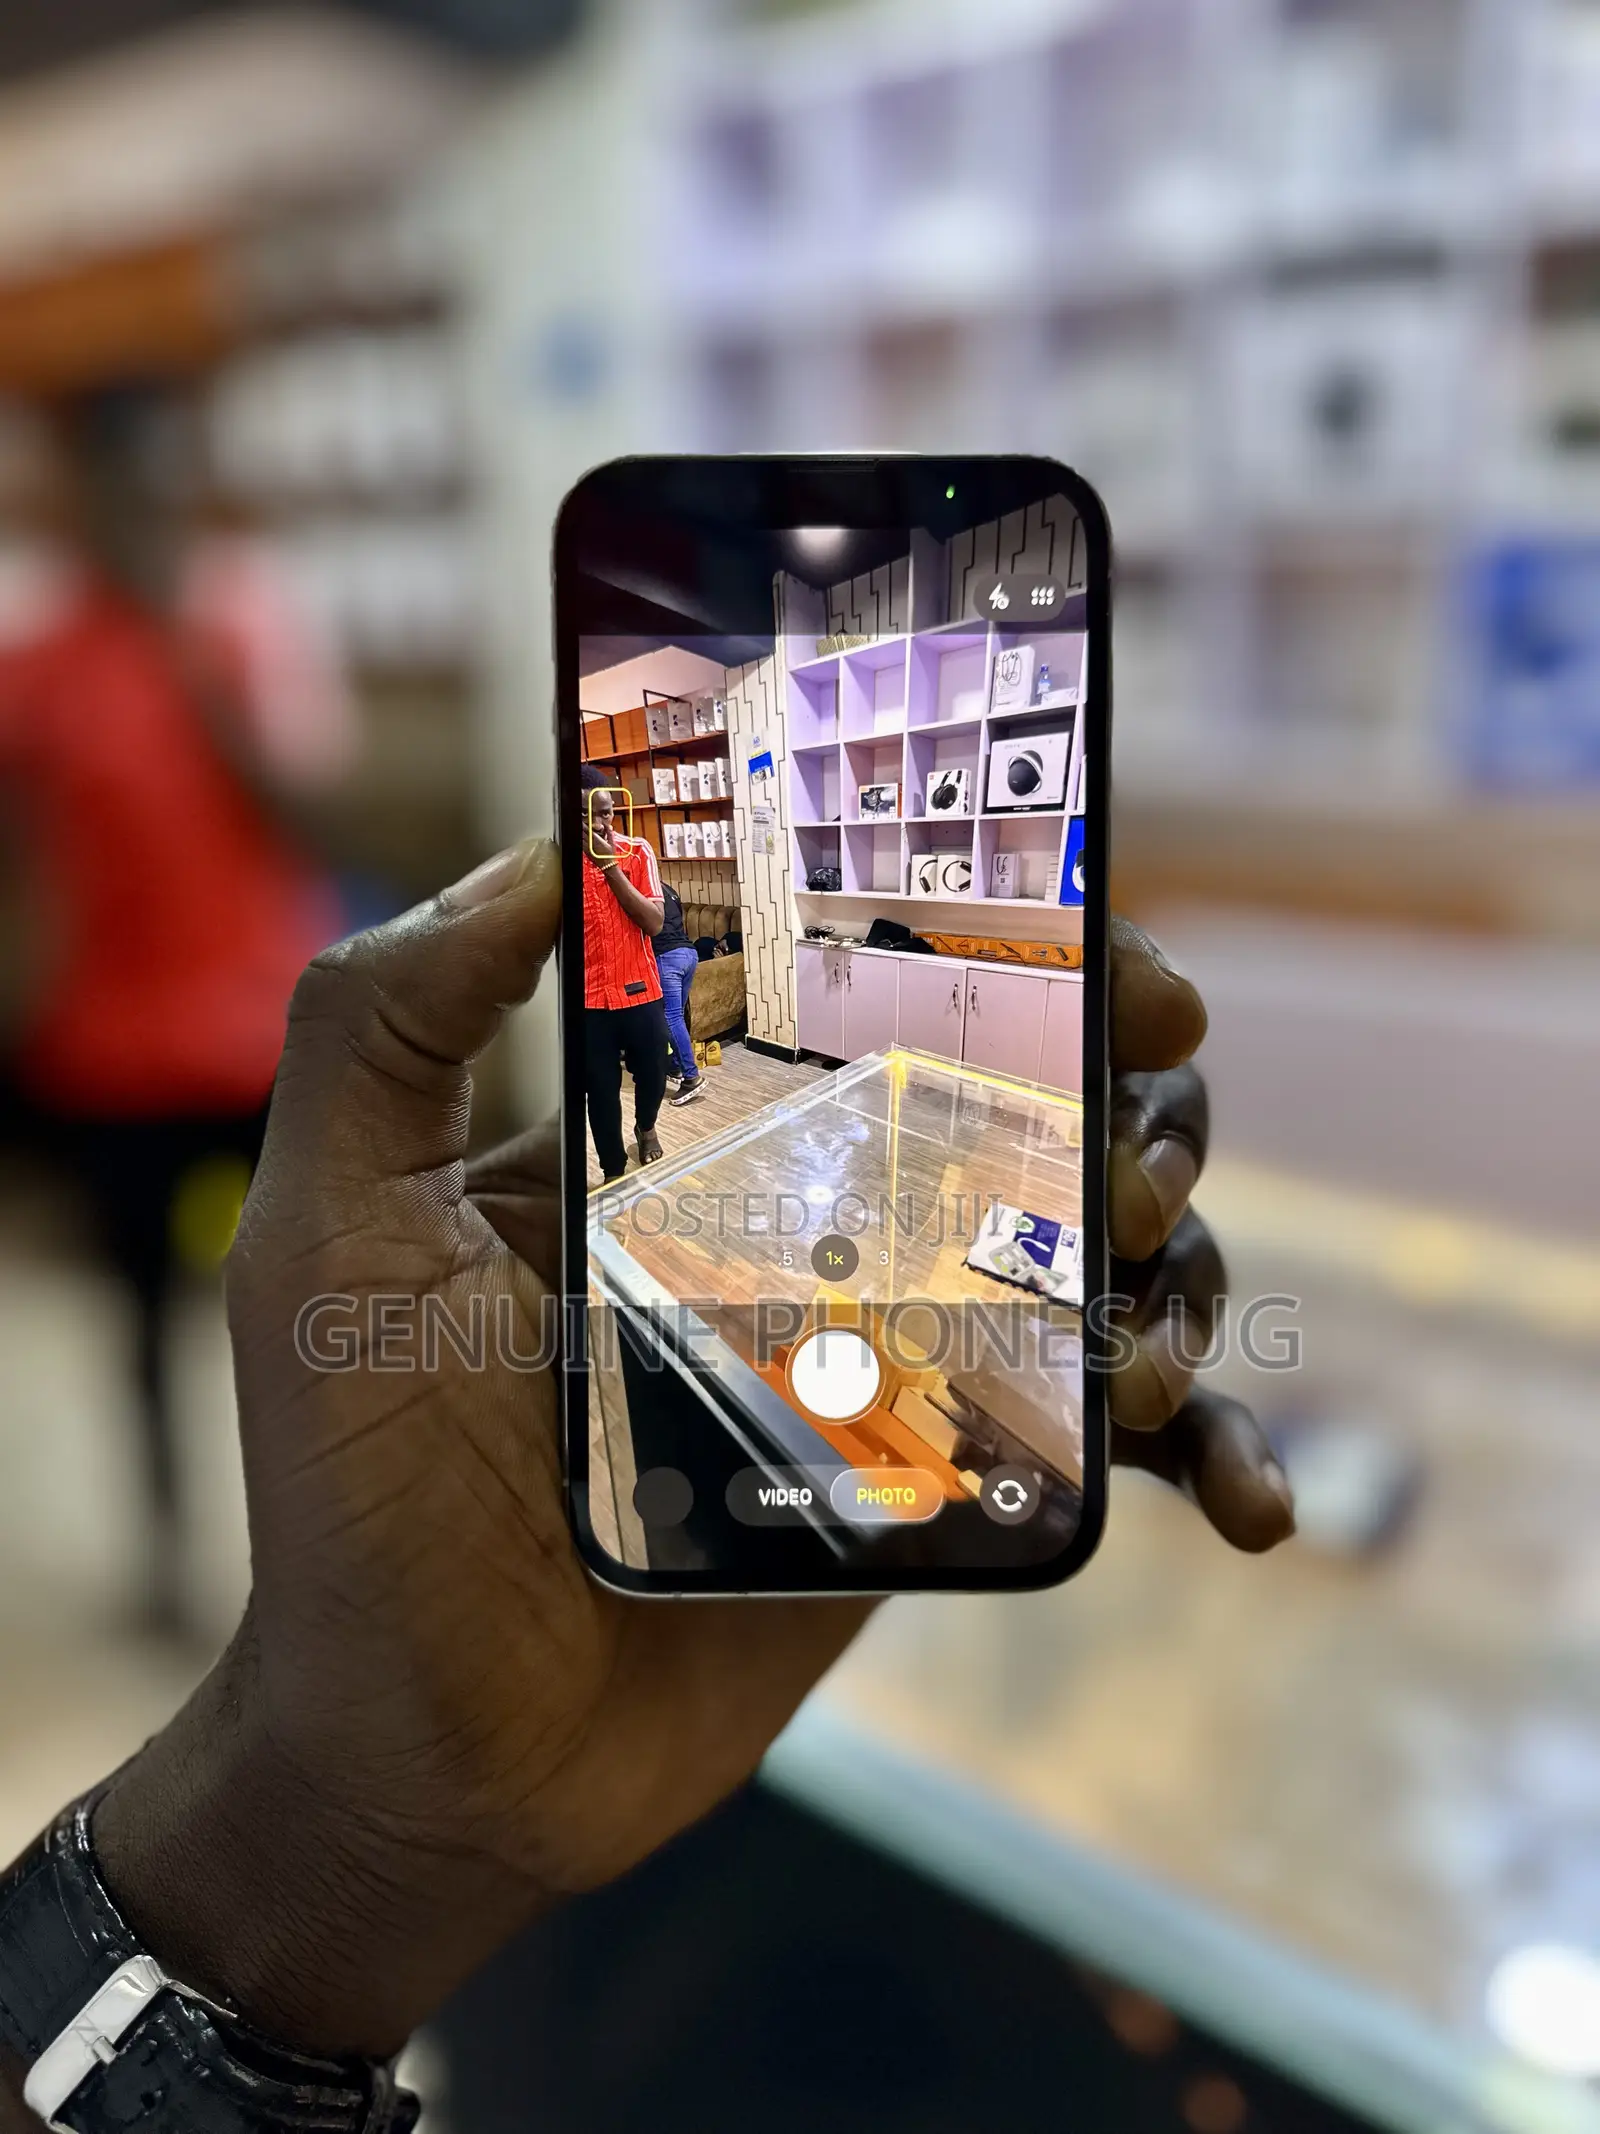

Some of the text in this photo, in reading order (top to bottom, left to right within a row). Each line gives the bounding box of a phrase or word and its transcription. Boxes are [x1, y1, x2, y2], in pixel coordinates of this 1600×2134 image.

[778, 1251, 793, 1266] .5
[826, 1251, 844, 1266] 1x
[879, 1251, 889, 1265] 3
[758, 1487, 813, 1506] VIDEO
[856, 1487, 917, 1506] PHOTO
